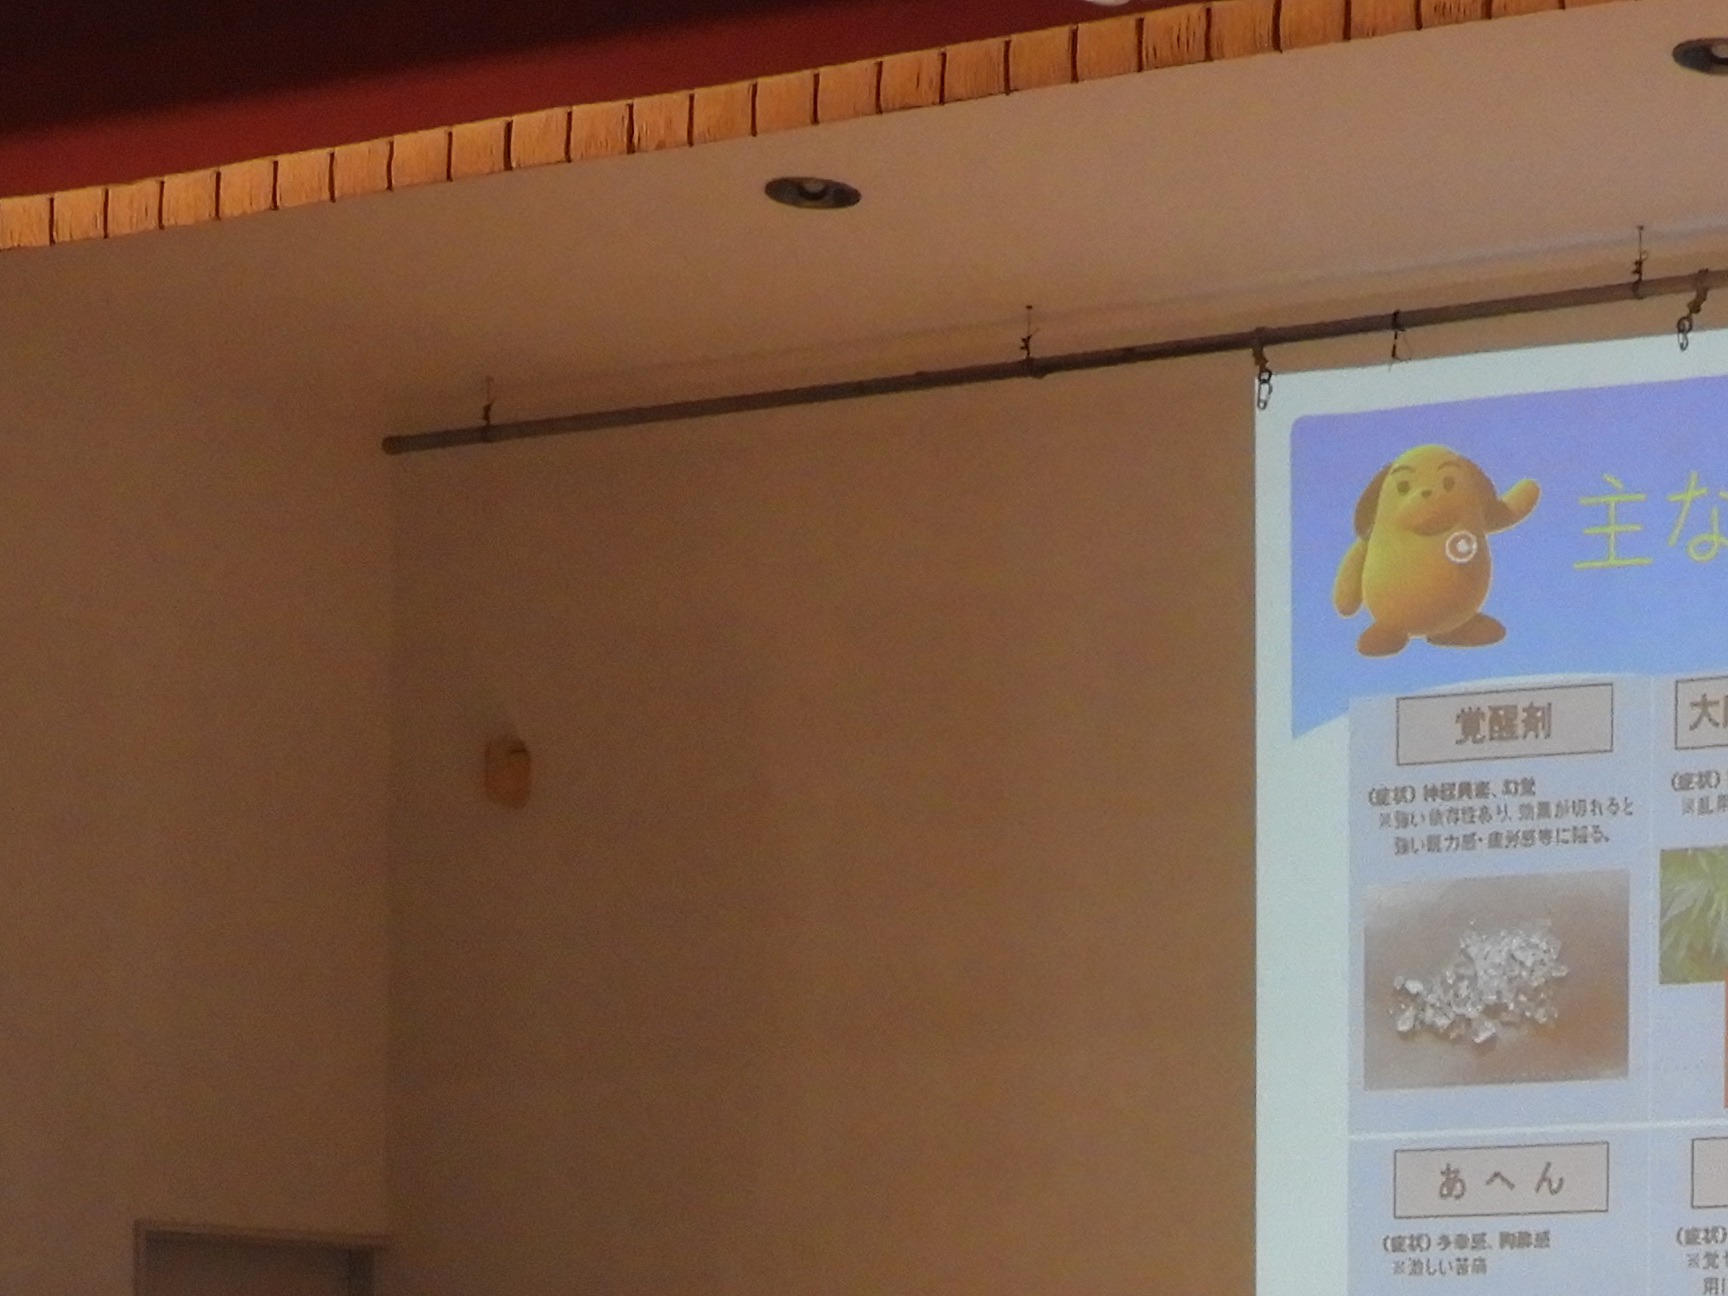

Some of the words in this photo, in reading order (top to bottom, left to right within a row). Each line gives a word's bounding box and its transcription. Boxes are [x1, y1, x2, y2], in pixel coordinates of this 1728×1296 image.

[1454, 701, 1553, 745] 覚醒剤
[1438, 1160, 1565, 1201] あへん
